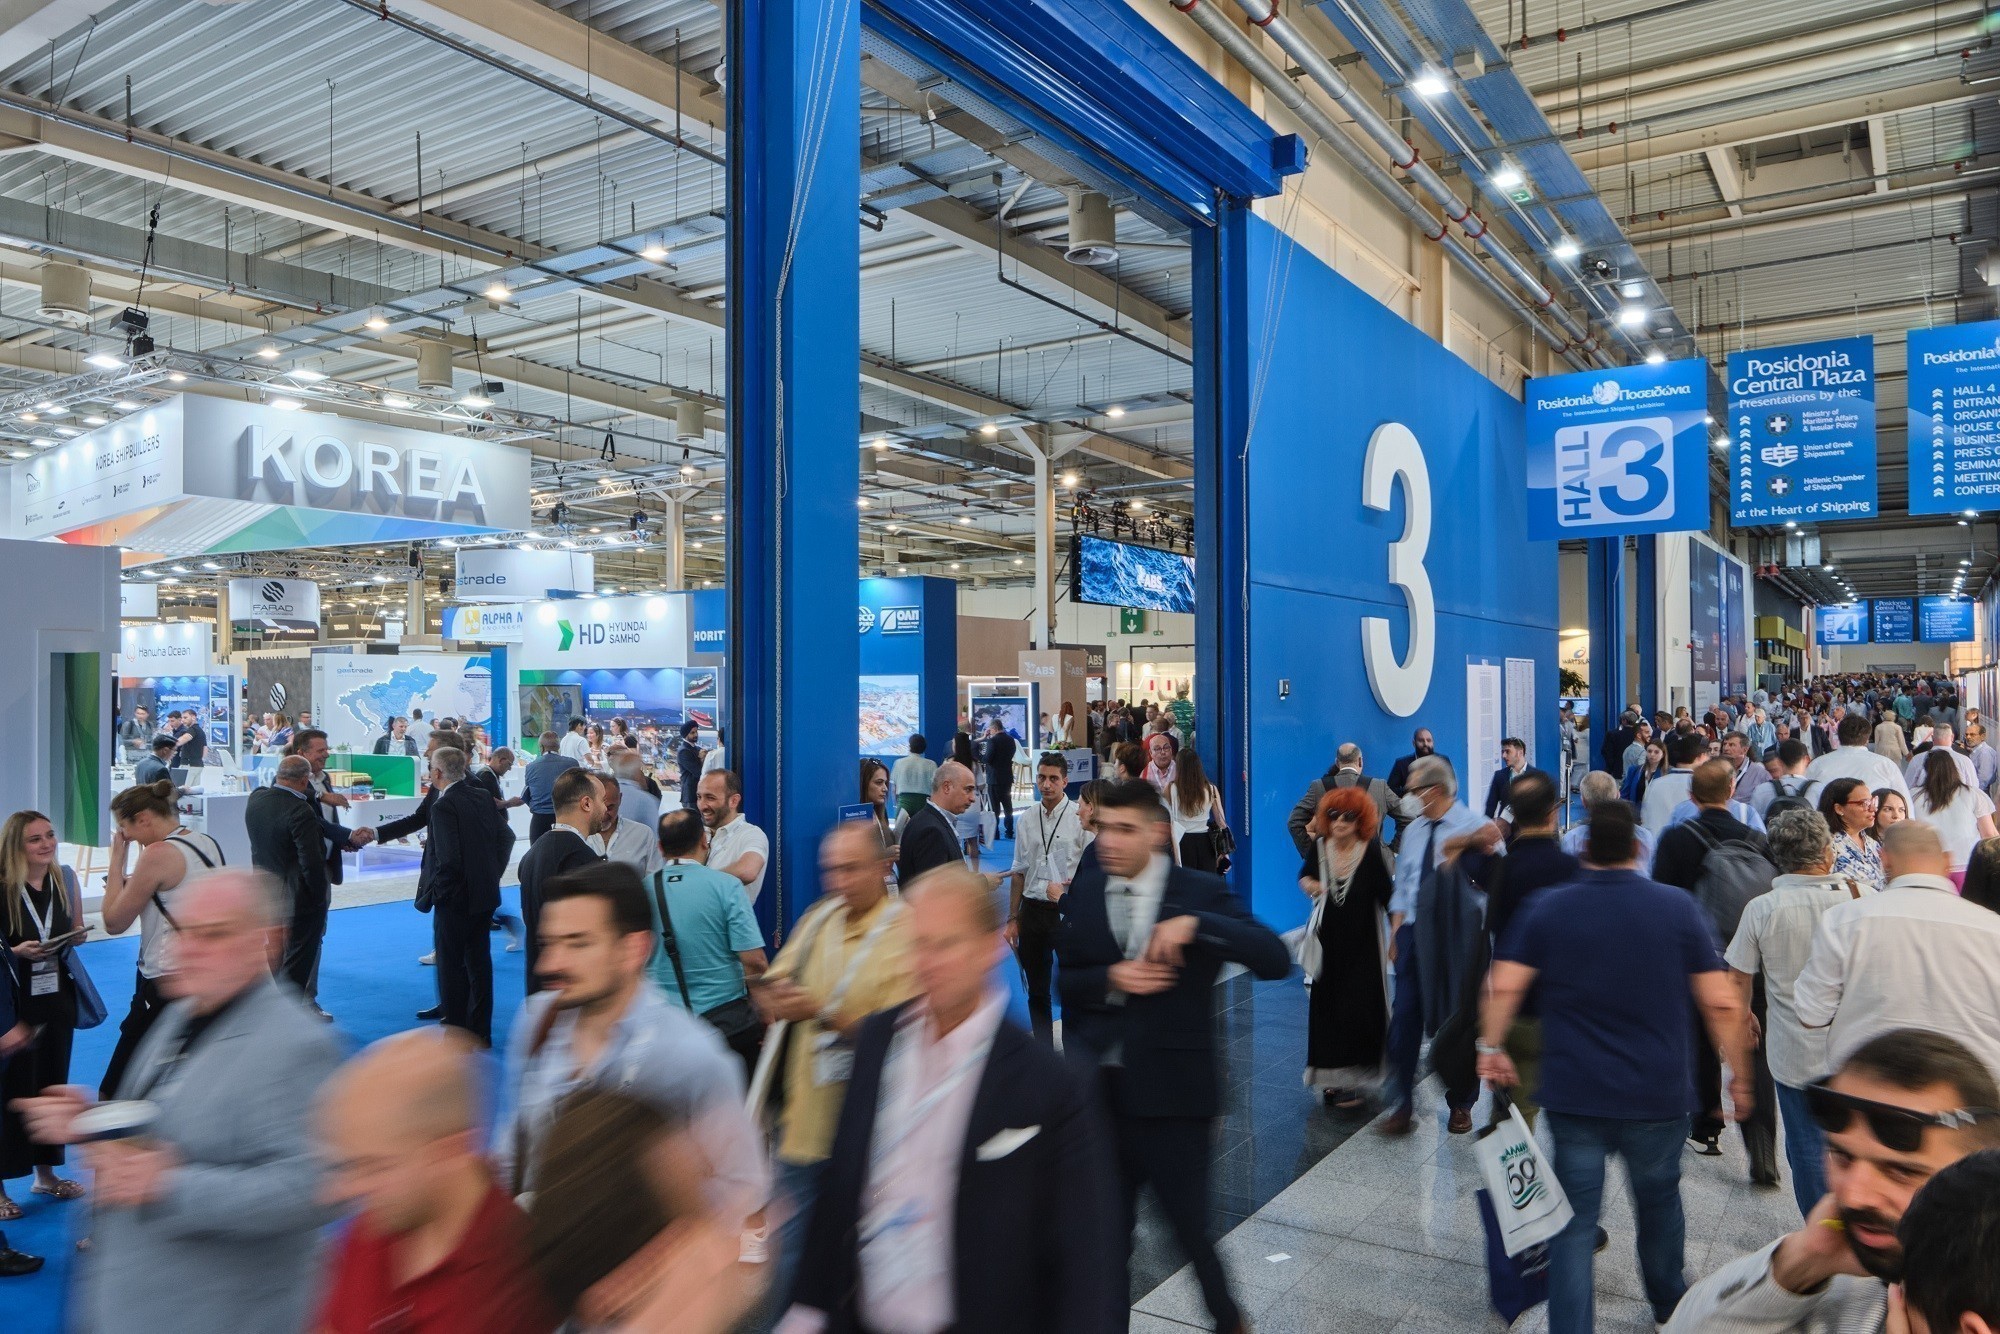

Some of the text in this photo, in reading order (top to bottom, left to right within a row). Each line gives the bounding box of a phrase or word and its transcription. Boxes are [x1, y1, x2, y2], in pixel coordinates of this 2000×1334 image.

[1924, 347, 1996, 365] Posidonia
[1748, 350, 1851, 378] Posidonia
[1732, 368, 1867, 396] Central Plaza
[1619, 384, 1691, 401] Ποσειδώνια
[1954, 384, 1996, 396] HALL 4
[1538, 394, 1594, 410] Posidonia
[1740, 388, 1862, 409] Presentations by the:
[1574, 408, 1610, 417] International
[1610, 404, 1636, 412] Shipping
[1636, 401, 1666, 410] Exhibition
[1802, 410, 1831, 418] Ministry
[1802, 417, 1834, 425] Maritime
[1836, 421, 1858, 430] Policy
[1954, 422, 1994, 434] HOUSE
[1832, 440, 1854, 448] Greek
[1803, 449, 1846, 459] Shipowners
[1954, 446, 1992, 458] PRESS
[247, 424, 487, 506] KOREA
[1562, 426, 1668, 521] HALL 3
[1803, 474, 1866, 484] Hellenic Chamber
[1812, 482, 1843, 492] Shipping
[1735, 500, 1870, 518] at the Heart of Shipping
[1361, 422, 1436, 718] 3
[1144, 574, 1163, 588] ABS
[482, 612, 512, 625] ALPHA
[609, 621, 647, 632] HYUNDAI
[1826, 615, 1857, 640] HALL 4
[579, 624, 605, 644] HD
[609, 633, 640, 644] SAMHO
[694, 630, 725, 641] HORIT
[139, 645, 191, 658] Hanwha Ocean
[1088, 654, 1103, 666] ABS
[1035, 666, 1055, 675] ABS
